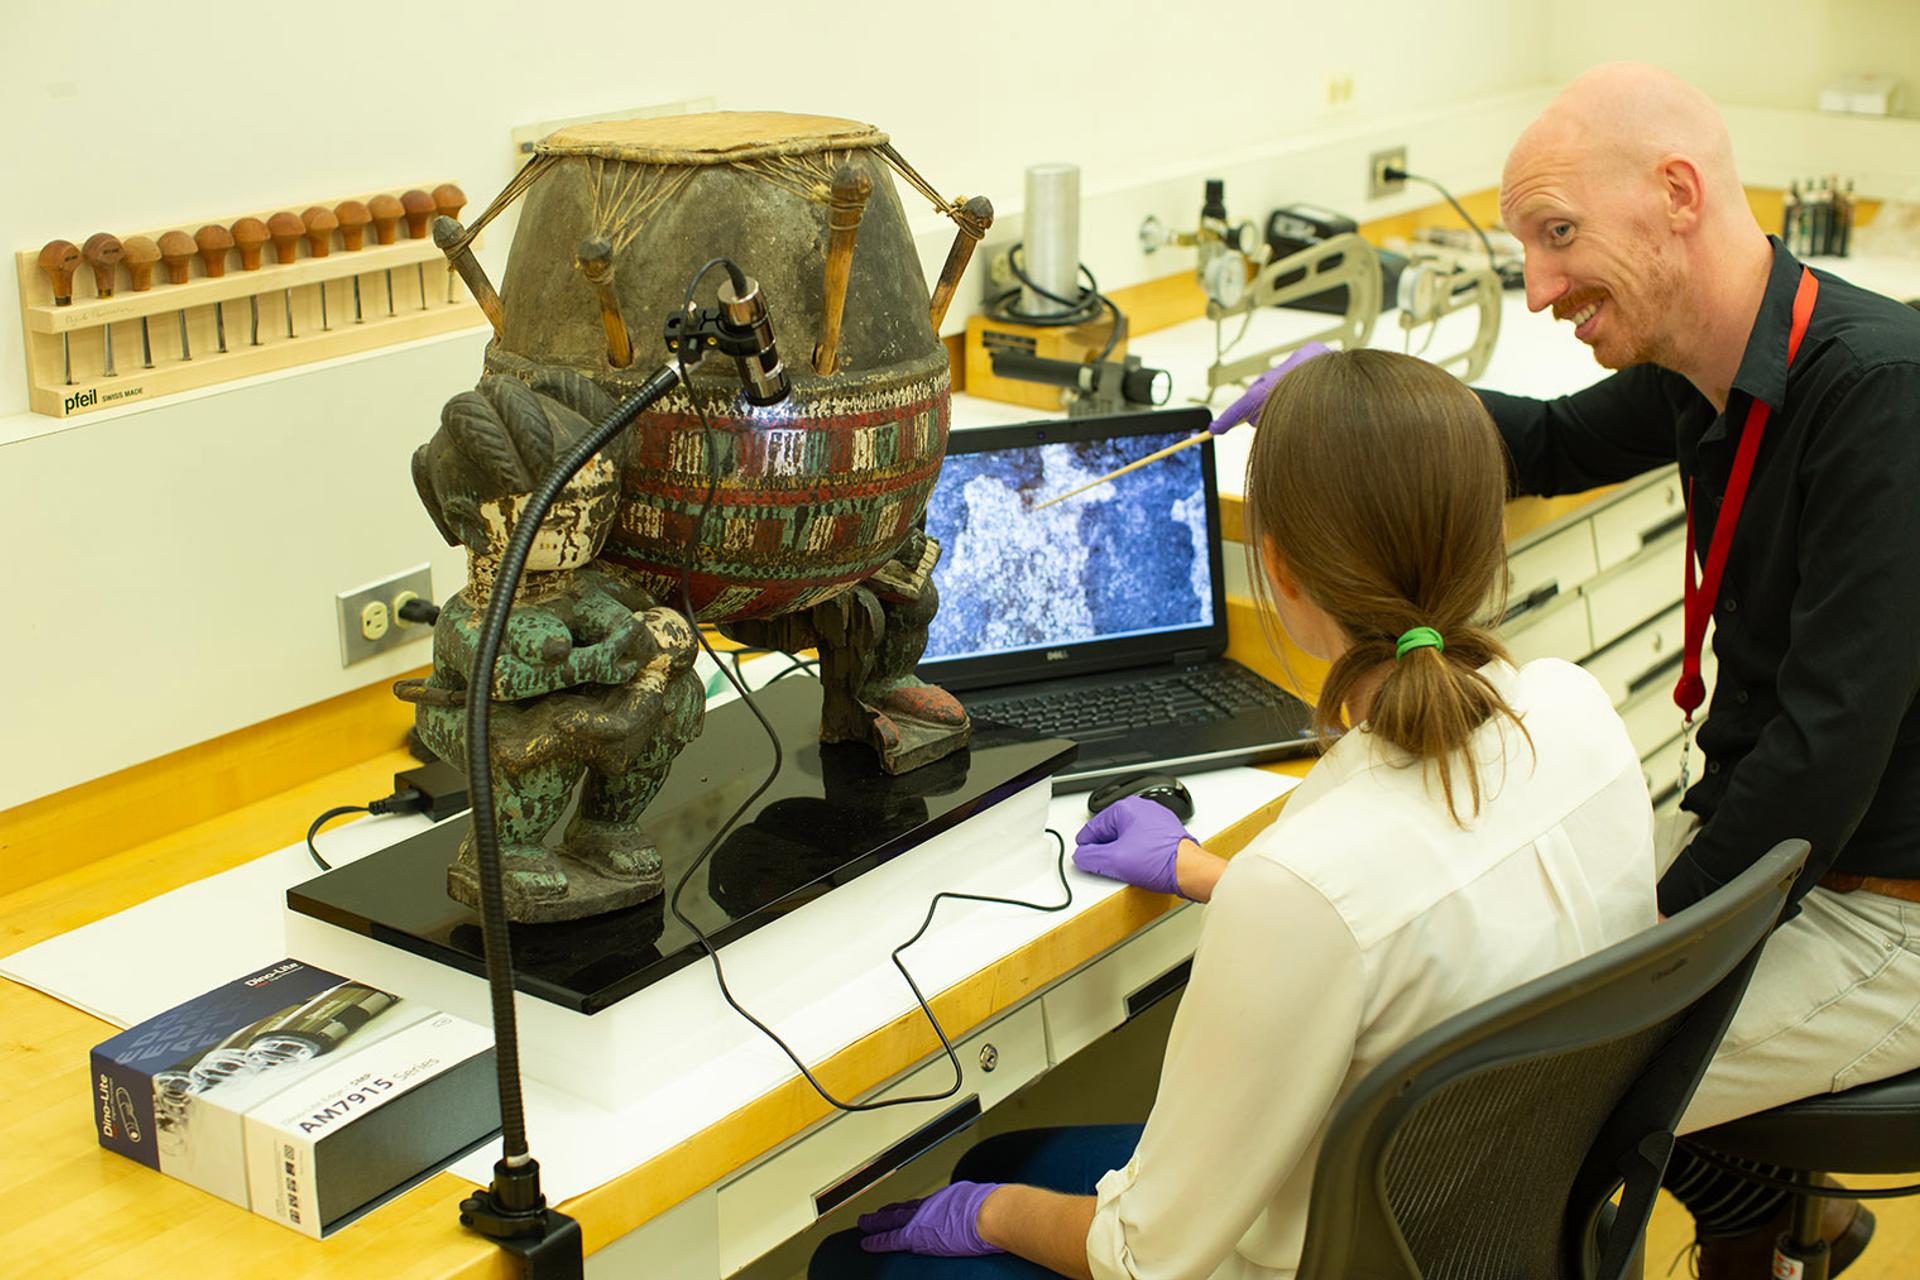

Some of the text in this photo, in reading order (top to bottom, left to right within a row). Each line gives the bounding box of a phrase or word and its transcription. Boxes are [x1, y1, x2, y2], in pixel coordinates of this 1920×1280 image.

[64, 387, 143, 415] pfeil SWISS MADE
[244, 962, 299, 987] Dino-Lite
[99, 1074, 113, 1137] Dino-Lite
[299, 1077, 394, 1134] AM7915
[392, 1057, 441, 1081] Series
